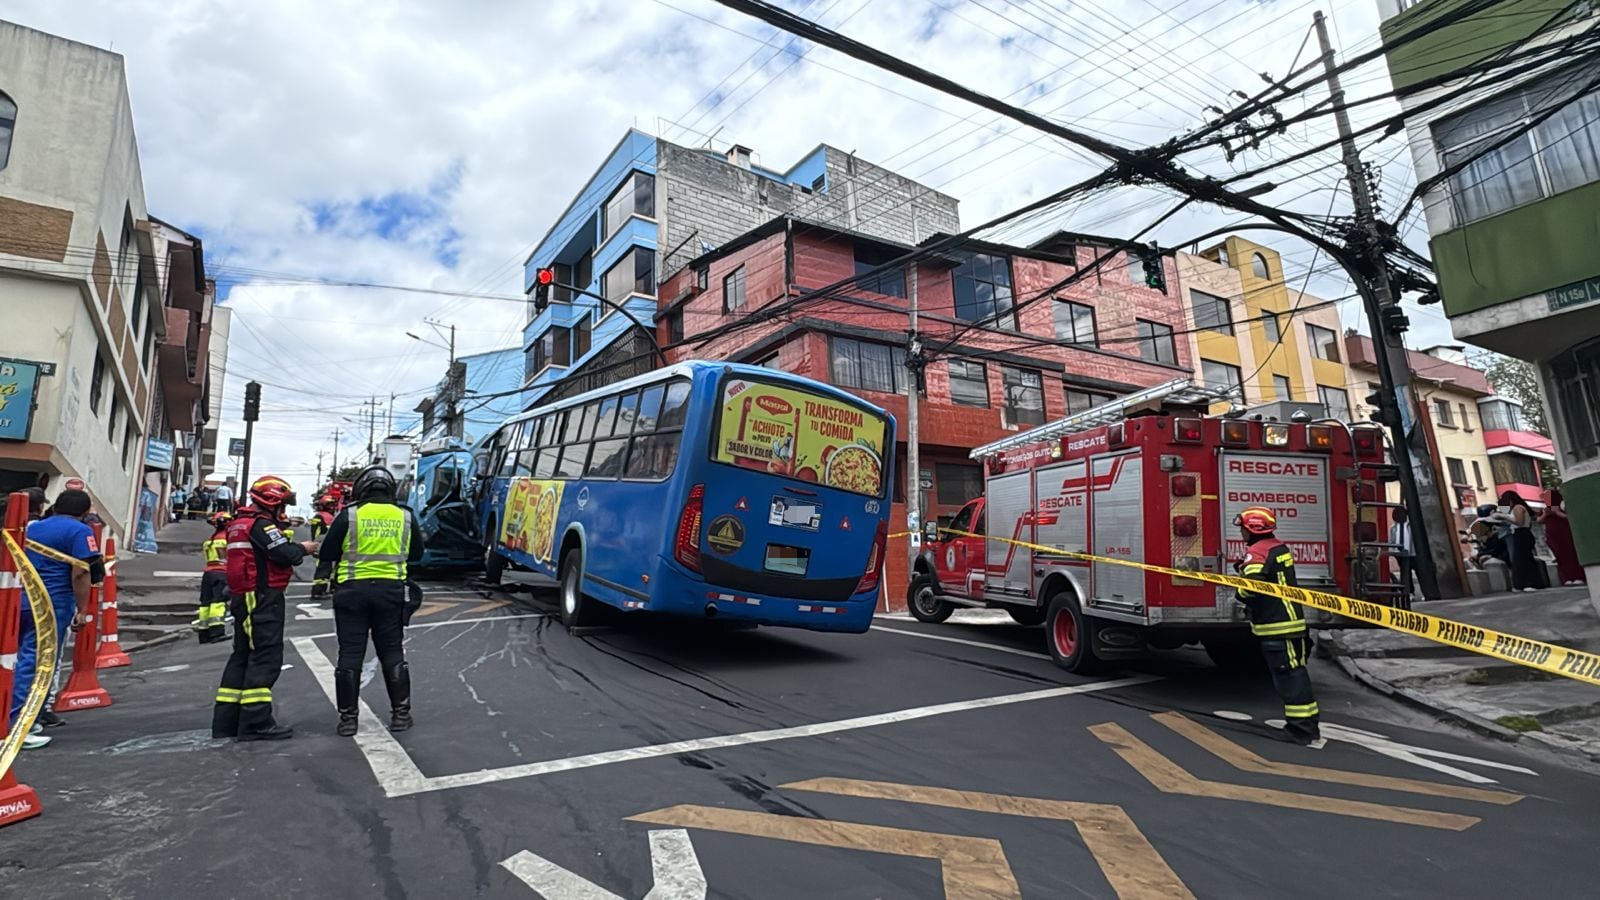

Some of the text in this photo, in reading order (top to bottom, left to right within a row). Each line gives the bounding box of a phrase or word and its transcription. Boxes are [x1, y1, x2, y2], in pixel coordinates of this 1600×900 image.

[759, 398, 789, 412] Maggi
[804, 400, 864, 428] TRANSFORMA
[810, 420, 819, 431] TU
[728, 441, 749, 455] SABOR
[754, 447, 774, 459] COLOR
[1068, 435, 1106, 451] RESCATE
[1229, 460, 1319, 476] RESCATE
[1039, 495, 1083, 509] RESCATE
[1228, 491, 1318, 504] BOMBEROS
[363, 528, 379, 538] ACT
[1279, 585, 1307, 602] PELIGRO
[1309, 591, 1343, 611] PELIGRO
[1349, 600, 1382, 622] PELIGRO
[1389, 609, 1429, 634] PELIGRO
[1436, 621, 1485, 648] PELIGRO
[1492, 634, 1553, 665] PELIGRO
